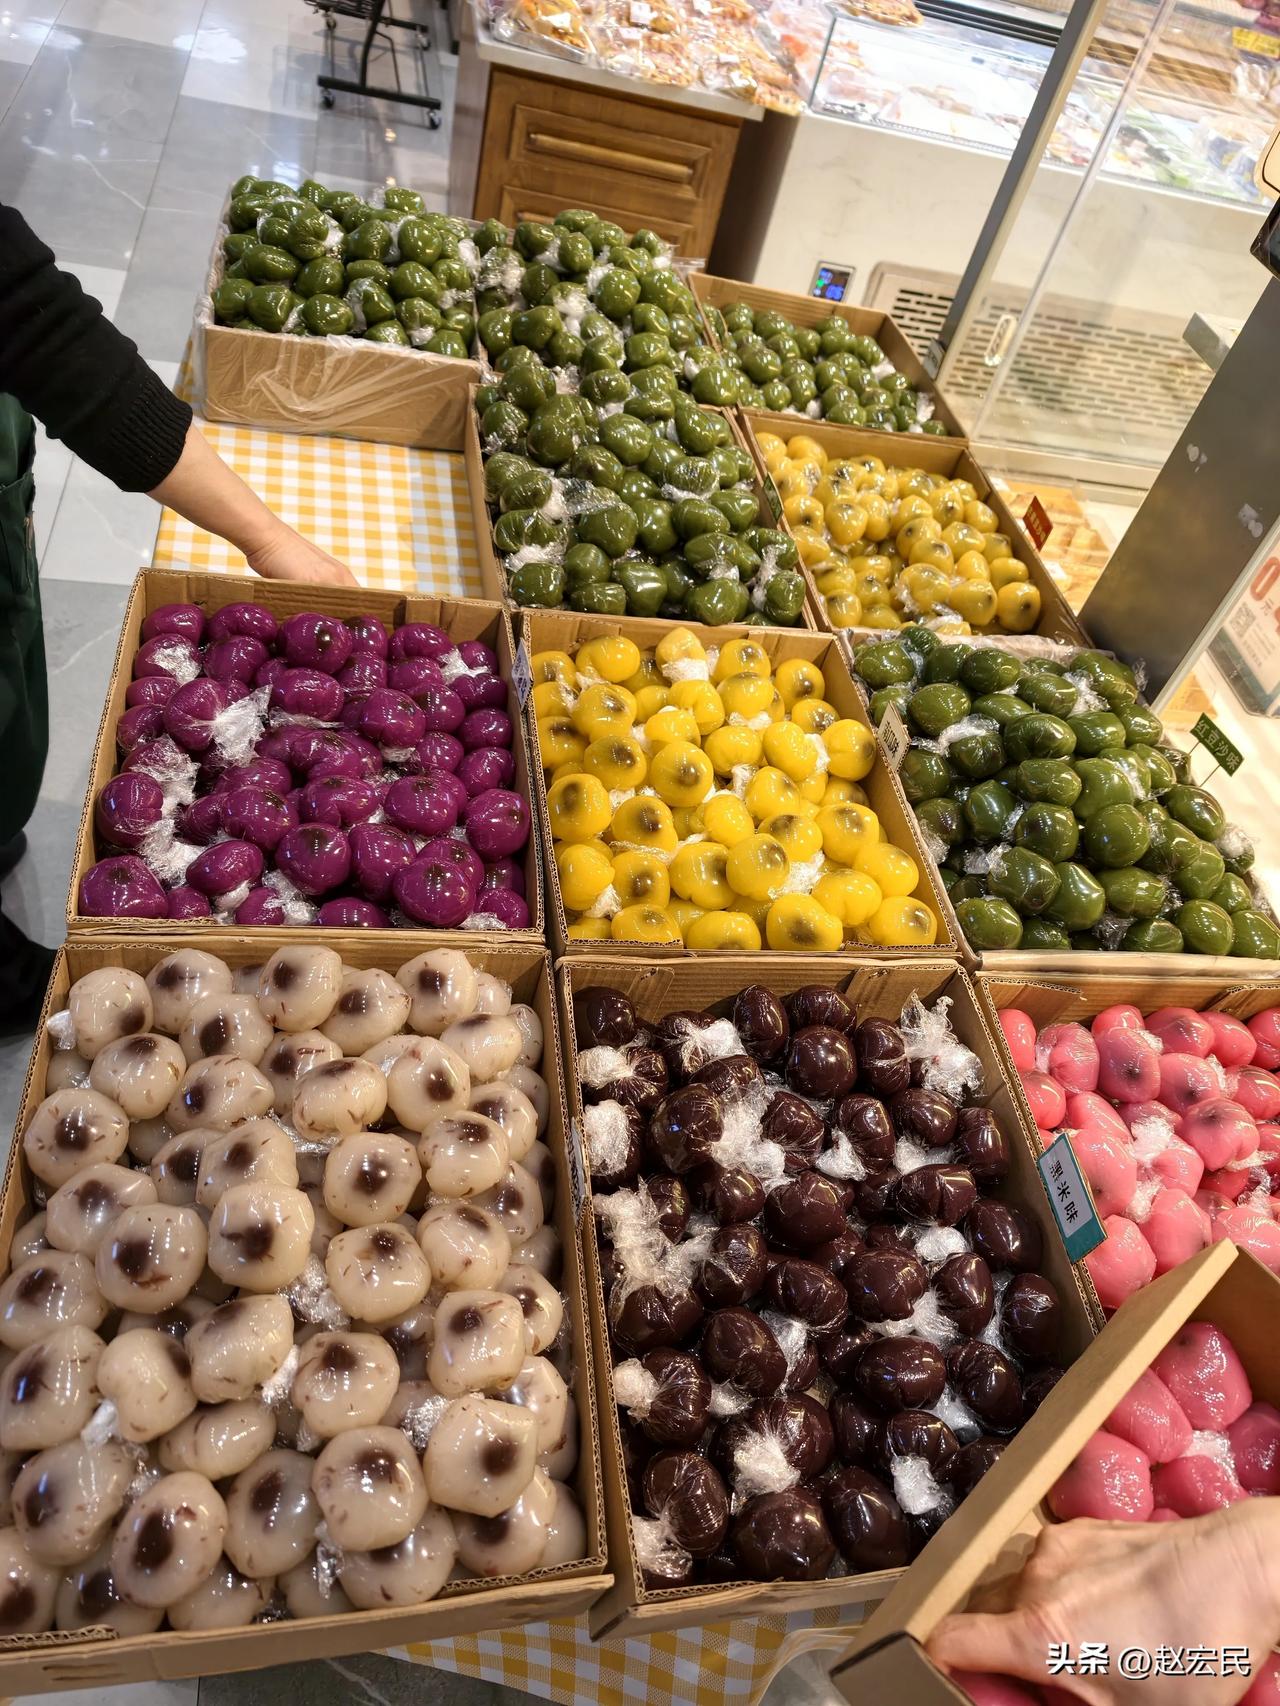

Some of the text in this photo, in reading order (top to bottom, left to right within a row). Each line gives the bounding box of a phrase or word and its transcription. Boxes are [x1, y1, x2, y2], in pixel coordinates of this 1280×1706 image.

[1195, 720, 1240, 770] 红豆沙味
[1049, 1160, 1079, 1223] 黑米味
